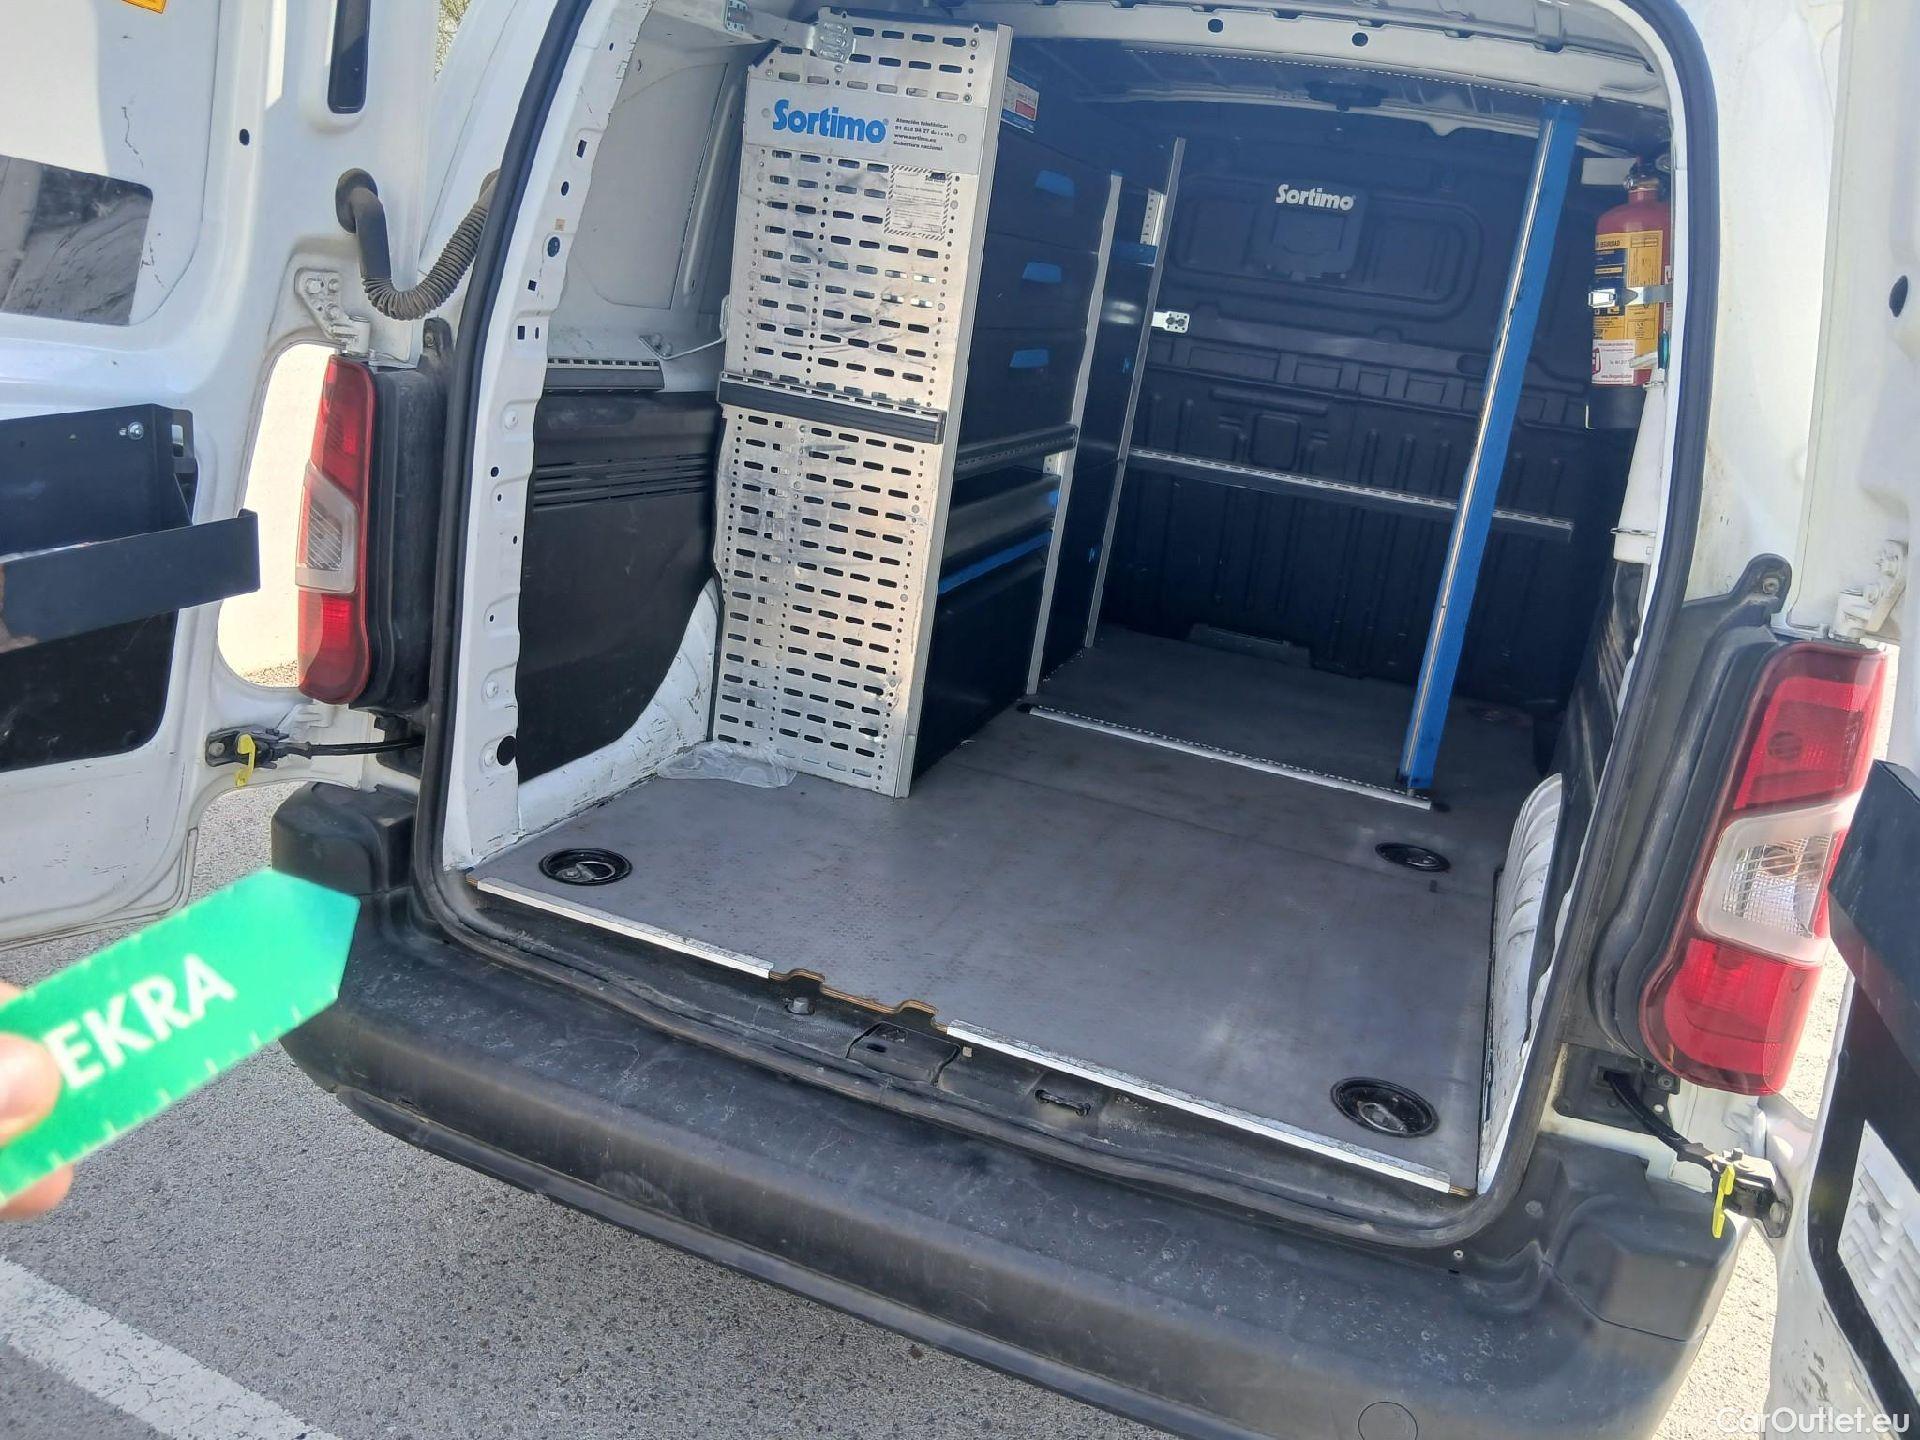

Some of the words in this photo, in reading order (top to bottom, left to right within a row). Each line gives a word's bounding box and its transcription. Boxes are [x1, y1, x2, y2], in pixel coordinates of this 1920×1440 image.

[773, 99, 886, 143] Sortimo
[1276, 183, 1354, 211] Sortimo
[43, 953, 236, 1089] EKRA
